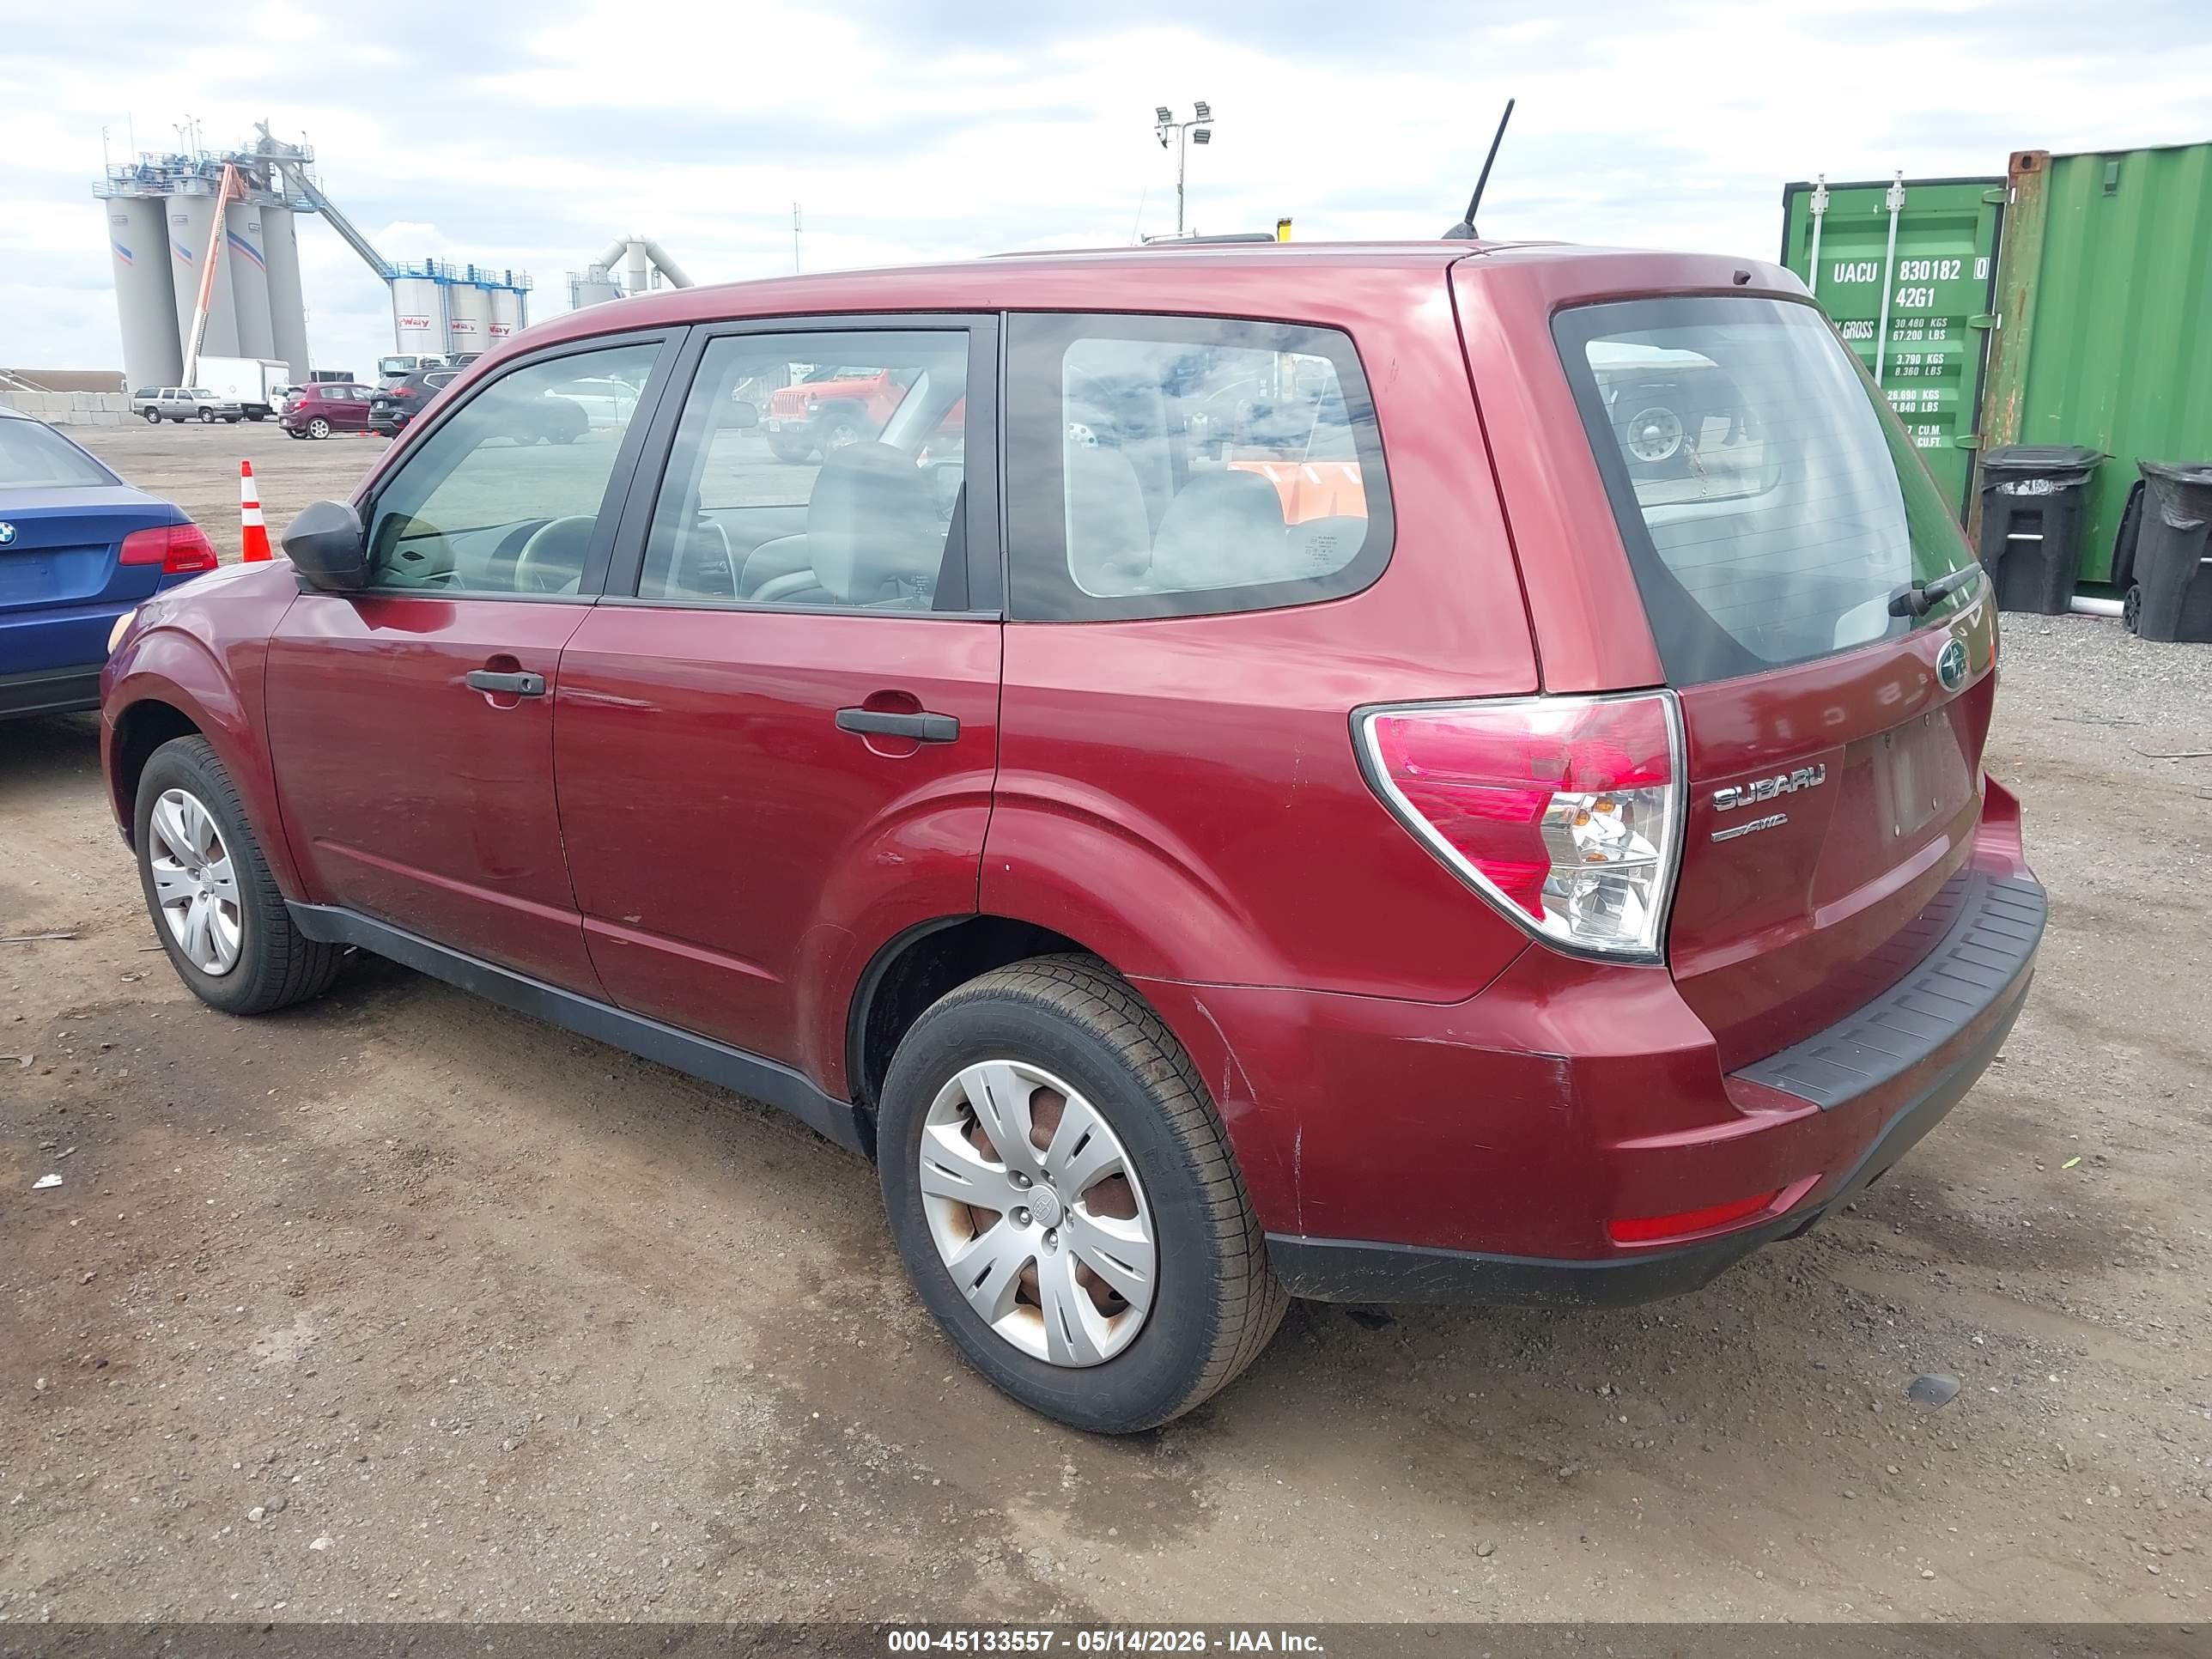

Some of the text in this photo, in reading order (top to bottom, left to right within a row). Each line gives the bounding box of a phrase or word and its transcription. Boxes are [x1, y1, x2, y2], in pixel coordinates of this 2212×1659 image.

[1833, 263, 1877, 283] UACU
[1899, 260, 1960, 281] 830182
[1896, 288, 1935, 307] 42G1
[1930, 318, 1948, 328] KGS
[1843, 320, 1874, 339] GROSS
[1893, 329, 1946, 341] 67.200 LBS
[1896, 353, 1944, 365] 3.790 KGS
[1924, 365, 1942, 376] LBS
[1923, 390, 1940, 400] KGS
[1922, 401, 1939, 412] LBS
[1918, 424, 1941, 435] CU.M.
[1713, 763, 1826, 811] SUBARU
